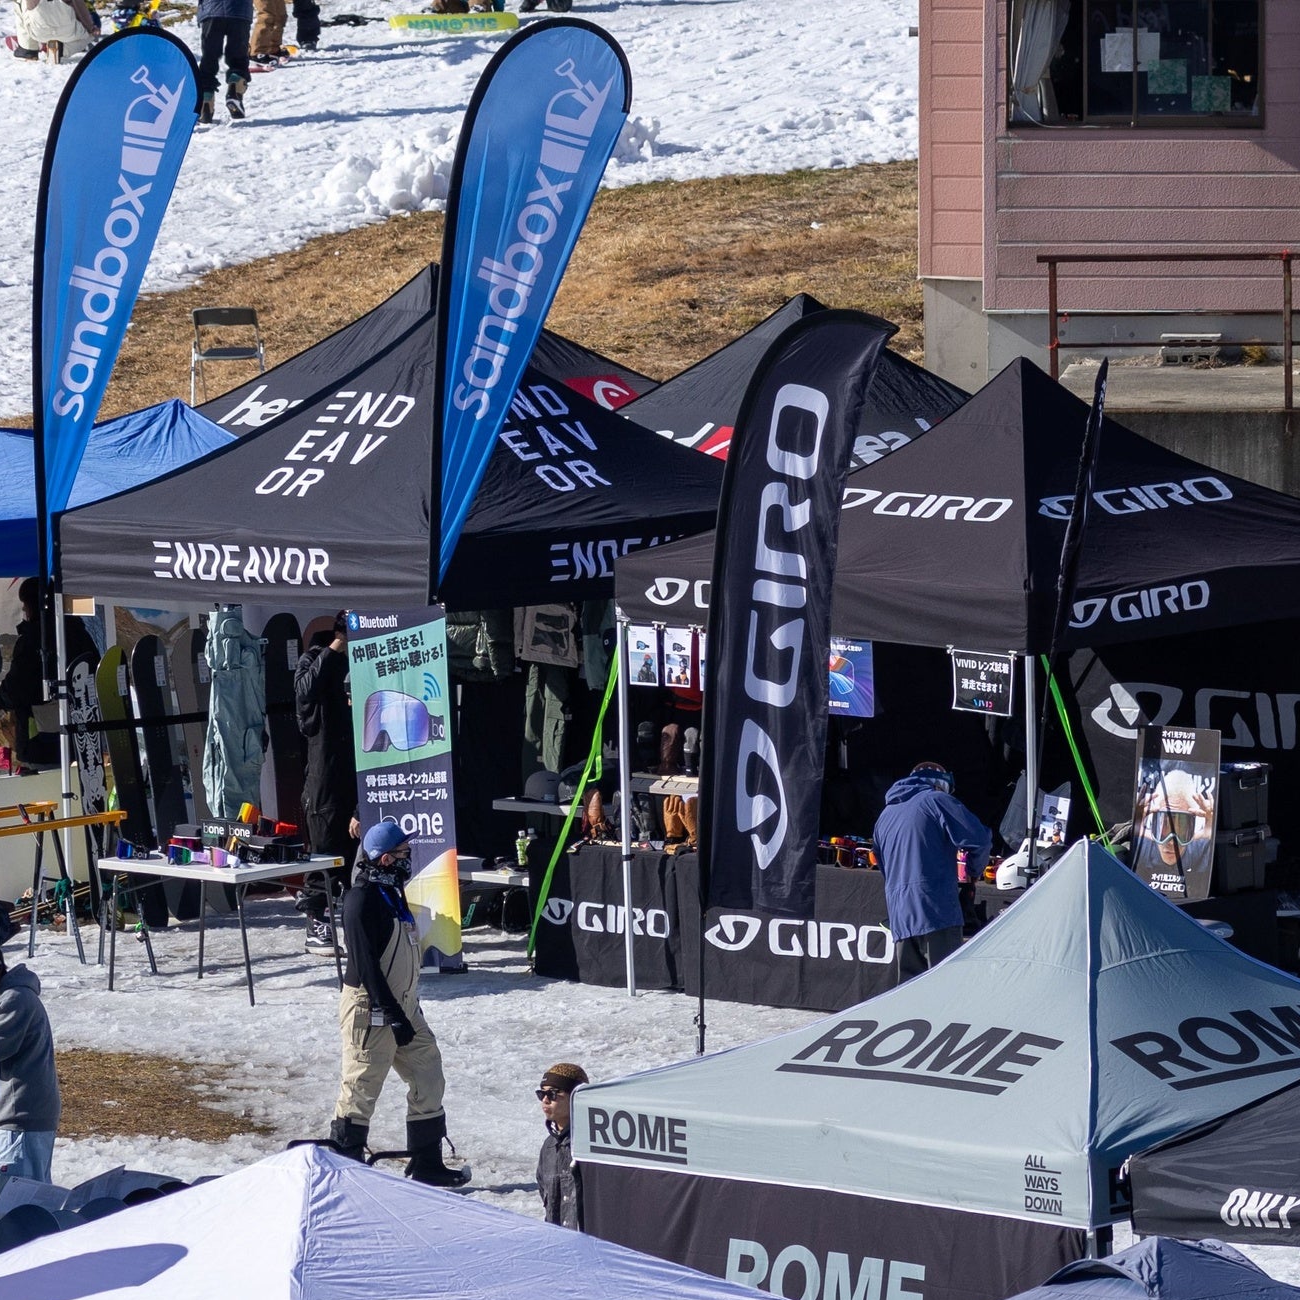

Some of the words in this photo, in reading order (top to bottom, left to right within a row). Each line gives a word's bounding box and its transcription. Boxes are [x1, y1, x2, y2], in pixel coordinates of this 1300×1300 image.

[408, 16, 497, 30] SALOMON
[51, 174, 152, 423] sandbox
[453, 170, 572, 421] sandbox
[315, 391, 416, 428] END
[506, 384, 570, 422] ND
[284, 429, 388, 465] EAV
[499, 421, 598, 462] EAV
[255, 467, 325, 497] OR
[535, 459, 612, 492] OR
[870, 492, 1013, 522] GIRO
[1092, 475, 1234, 516] GIRO
[744, 382, 830, 708] GIRO
[153, 541, 331, 586] ENDEAVOR
[1110, 580, 1210, 622] GIRO
[359, 614, 399, 629] Bluetooth
[352, 631, 424, 664] 仲間と話せる!
[375, 643, 444, 678] 音楽が聴ける!
[956, 658, 977, 669] VIVID
[978, 659, 1009, 674] レンズ試着
[979, 672, 987, 681] &
[961, 679, 1003, 693] 滑走できます!
[431, 717, 445, 738] bo
[1162, 738, 1196, 755] WOW
[367, 787, 448, 804] 次世代スノーゴーグル
[203, 822, 225, 836] bone
[228, 823, 251, 838] bone
[379, 807, 444, 837] bone
[1160, 883, 1186, 892] GIRO
[577, 902, 670, 939] GIRO
[768, 918, 895, 964] GIRO
[798, 1017, 1066, 1083] ROME
[588, 1106, 687, 1150] ROME
[1024, 1154, 1047, 1169] ALL
[1024, 1174, 1059, 1191] WAYS
[1024, 1196, 1063, 1213] DOWN
